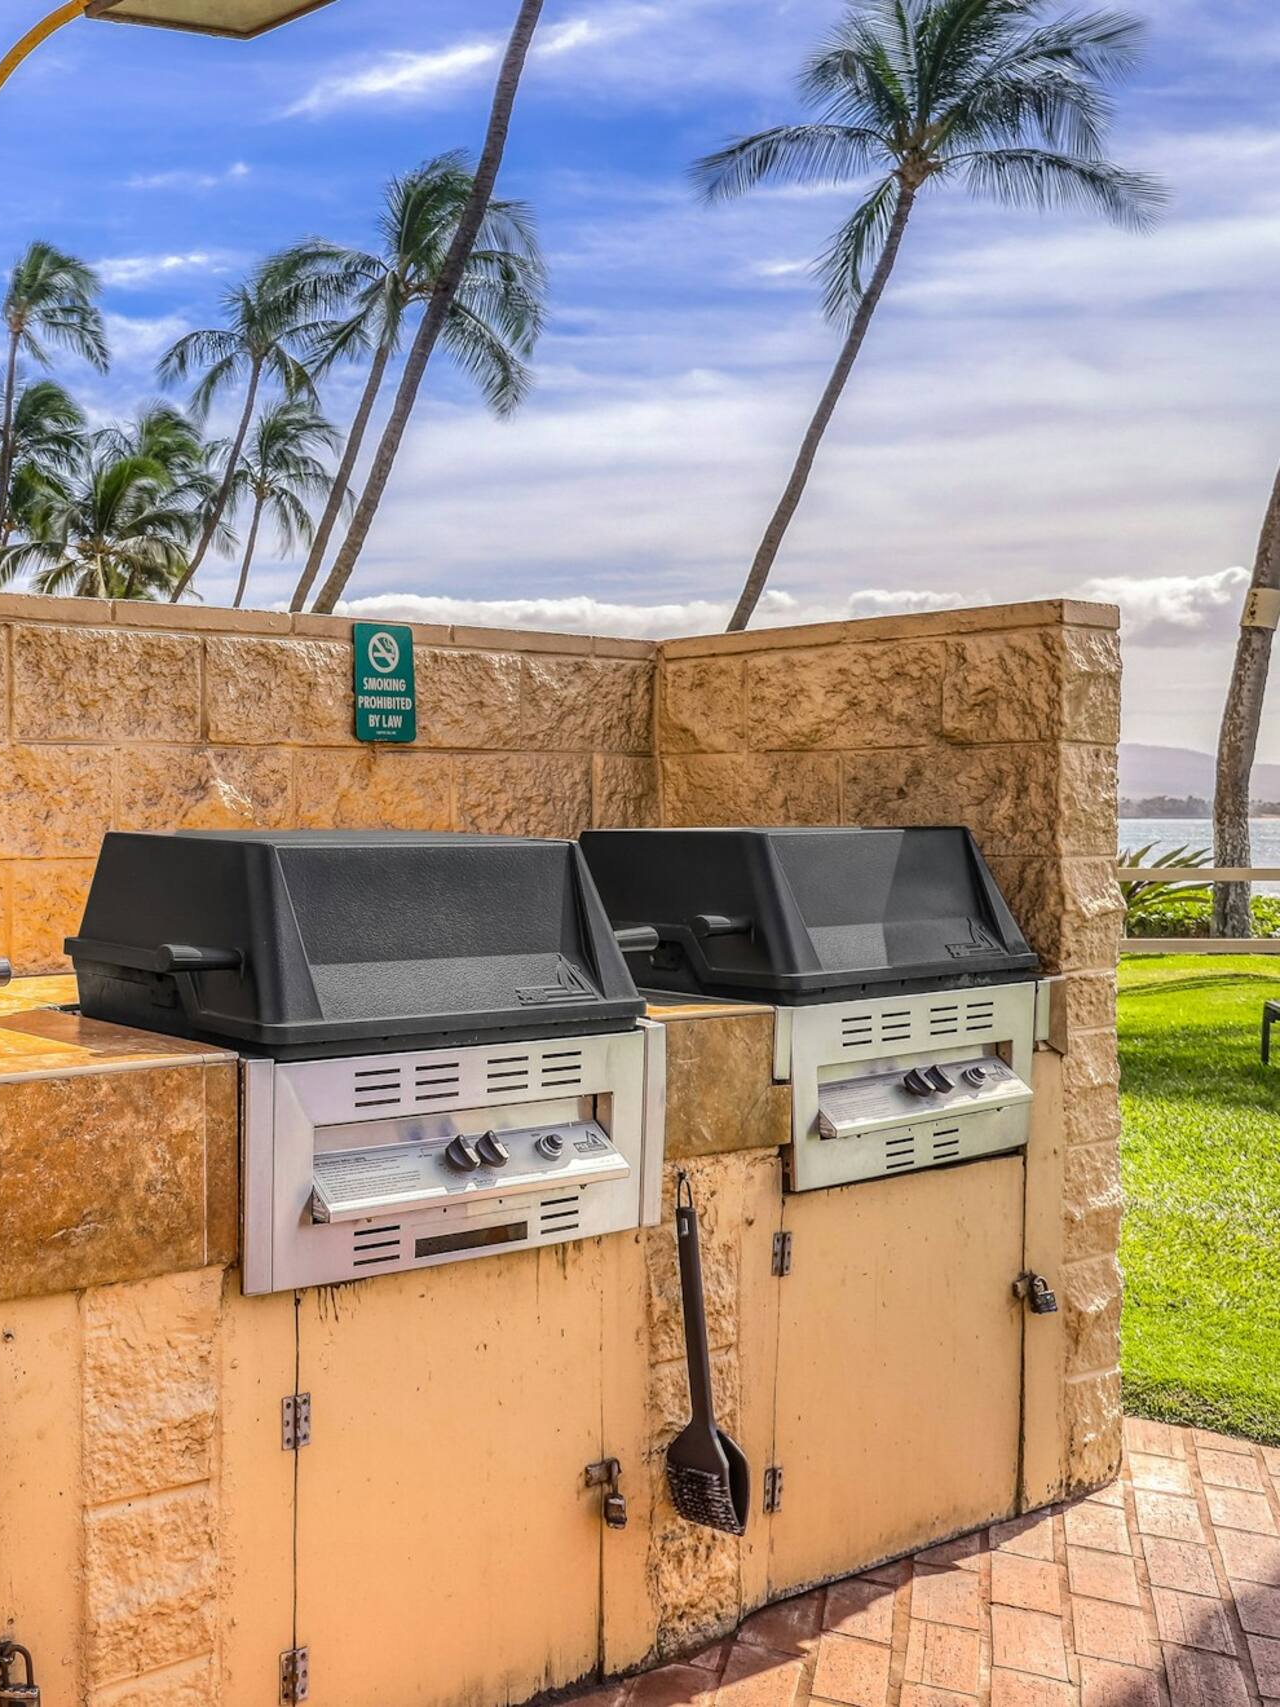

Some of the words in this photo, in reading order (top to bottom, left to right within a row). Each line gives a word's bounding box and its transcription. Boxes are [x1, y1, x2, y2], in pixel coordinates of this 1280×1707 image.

[363, 677, 406, 692] SMOKING
[358, 695, 412, 710] PROHIBITED
[368, 714, 380, 728] BY
[382, 714, 402, 728] LAW
